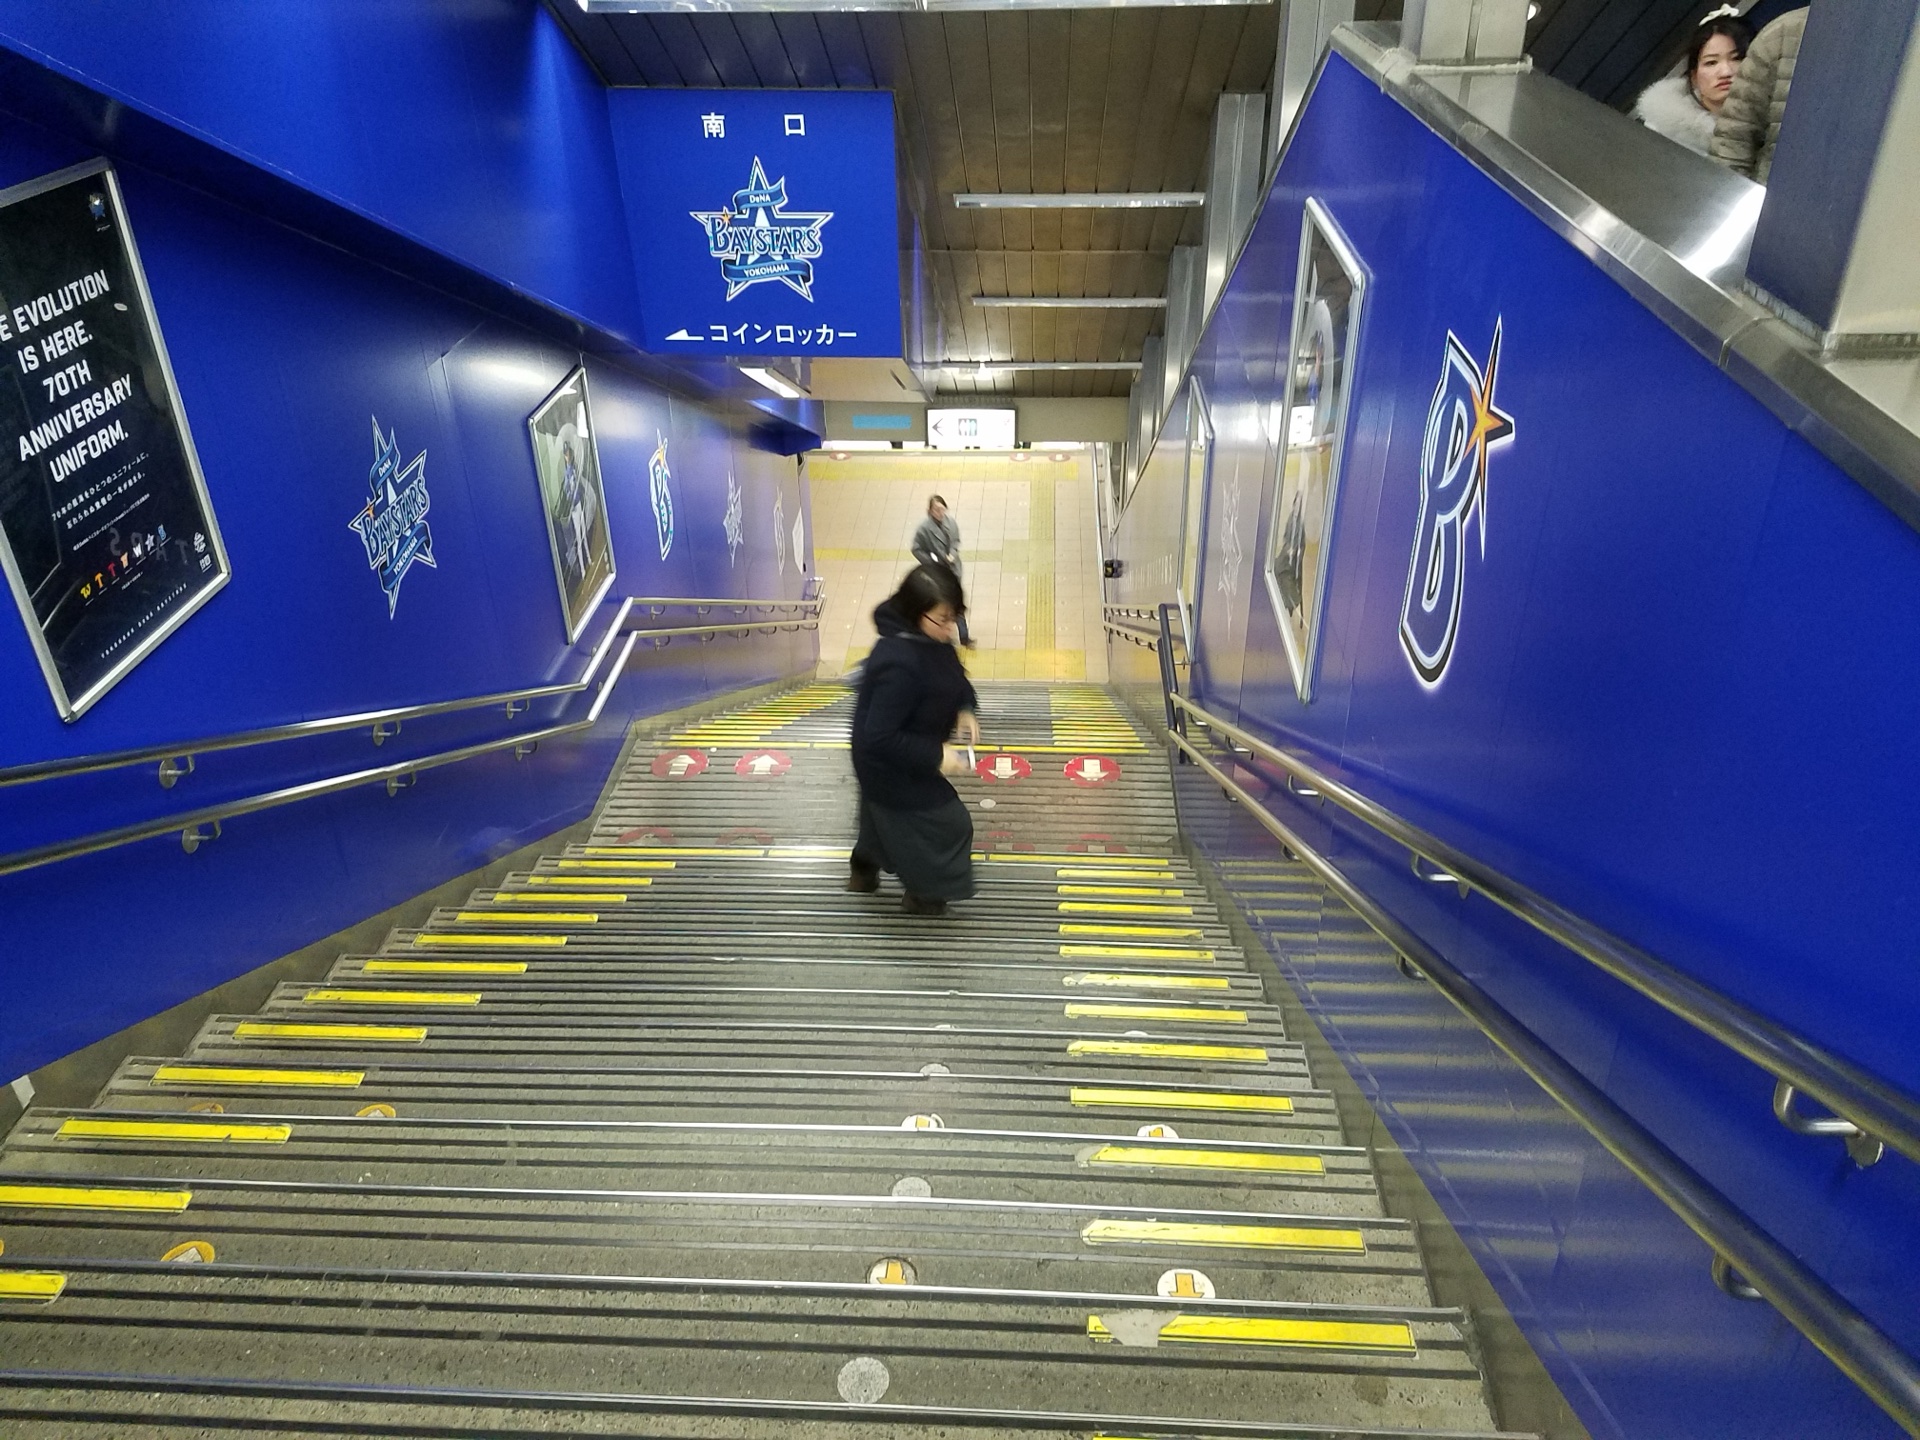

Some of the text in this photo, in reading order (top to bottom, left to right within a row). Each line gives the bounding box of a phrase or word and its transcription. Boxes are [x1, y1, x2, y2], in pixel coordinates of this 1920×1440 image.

[700, 111, 806, 139] 南口
[749, 194, 771, 204] DeNA
[709, 215, 821, 256] BAYSTARS
[744, 263, 790, 278] YOKOHAMA
[12, 268, 111, 334] EVOLUTION
[17, 319, 94, 375] IS HERE.
[709, 322, 858, 345] コインロッカー
[42, 358, 92, 403] 70TH
[18, 373, 132, 462] ANNIVERSARY
[49, 419, 129, 483] UNIFORM.
[360, 475, 431, 565] BAYSTARS
